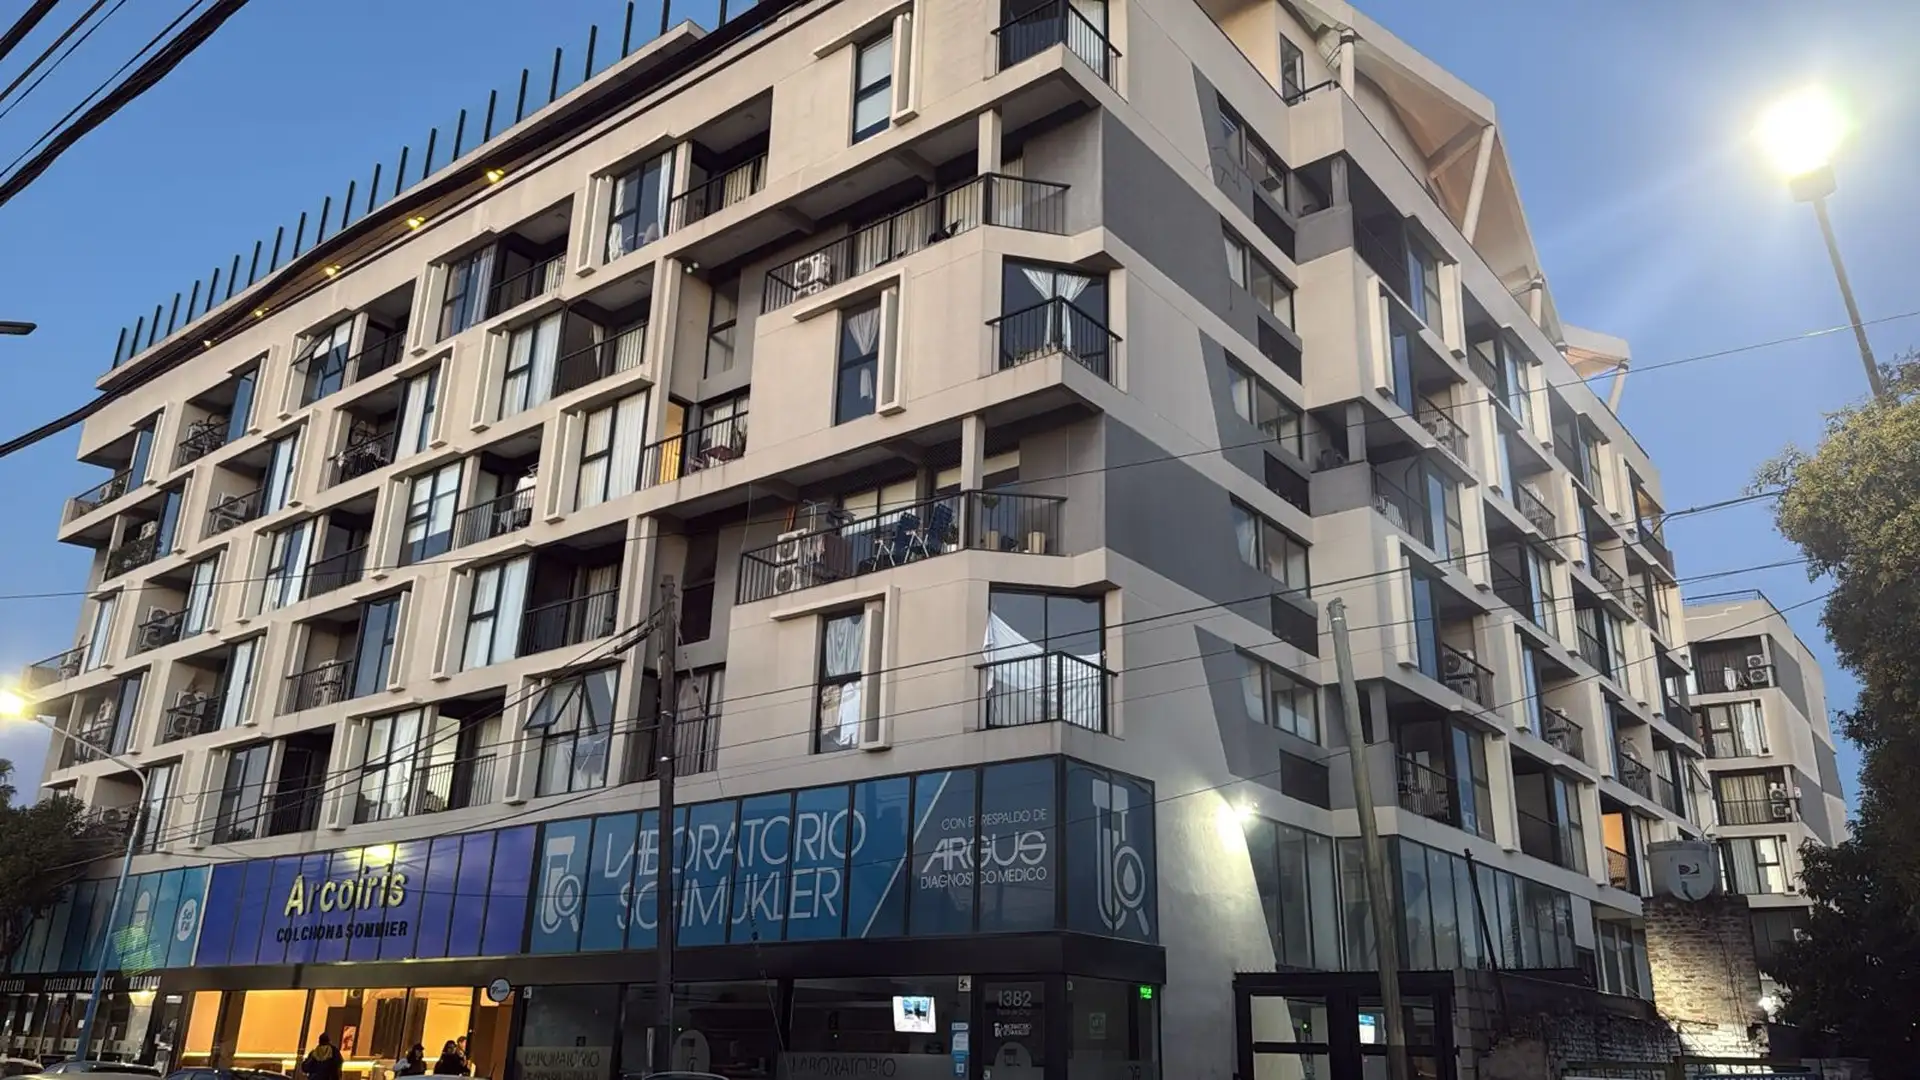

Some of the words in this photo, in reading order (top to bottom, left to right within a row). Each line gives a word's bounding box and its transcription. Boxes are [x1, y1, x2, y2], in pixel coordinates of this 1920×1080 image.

[941, 817, 966, 831] CON
[981, 809, 1031, 826] RESPALDO
[1034, 808, 1047, 821] DE
[604, 808, 866, 878] LABORATORIO
[921, 830, 1047, 873] ARGUS
[284, 863, 408, 917] Arcoiris
[998, 866, 1047, 884] MEDICO
[997, 989, 1032, 1007] 1382
